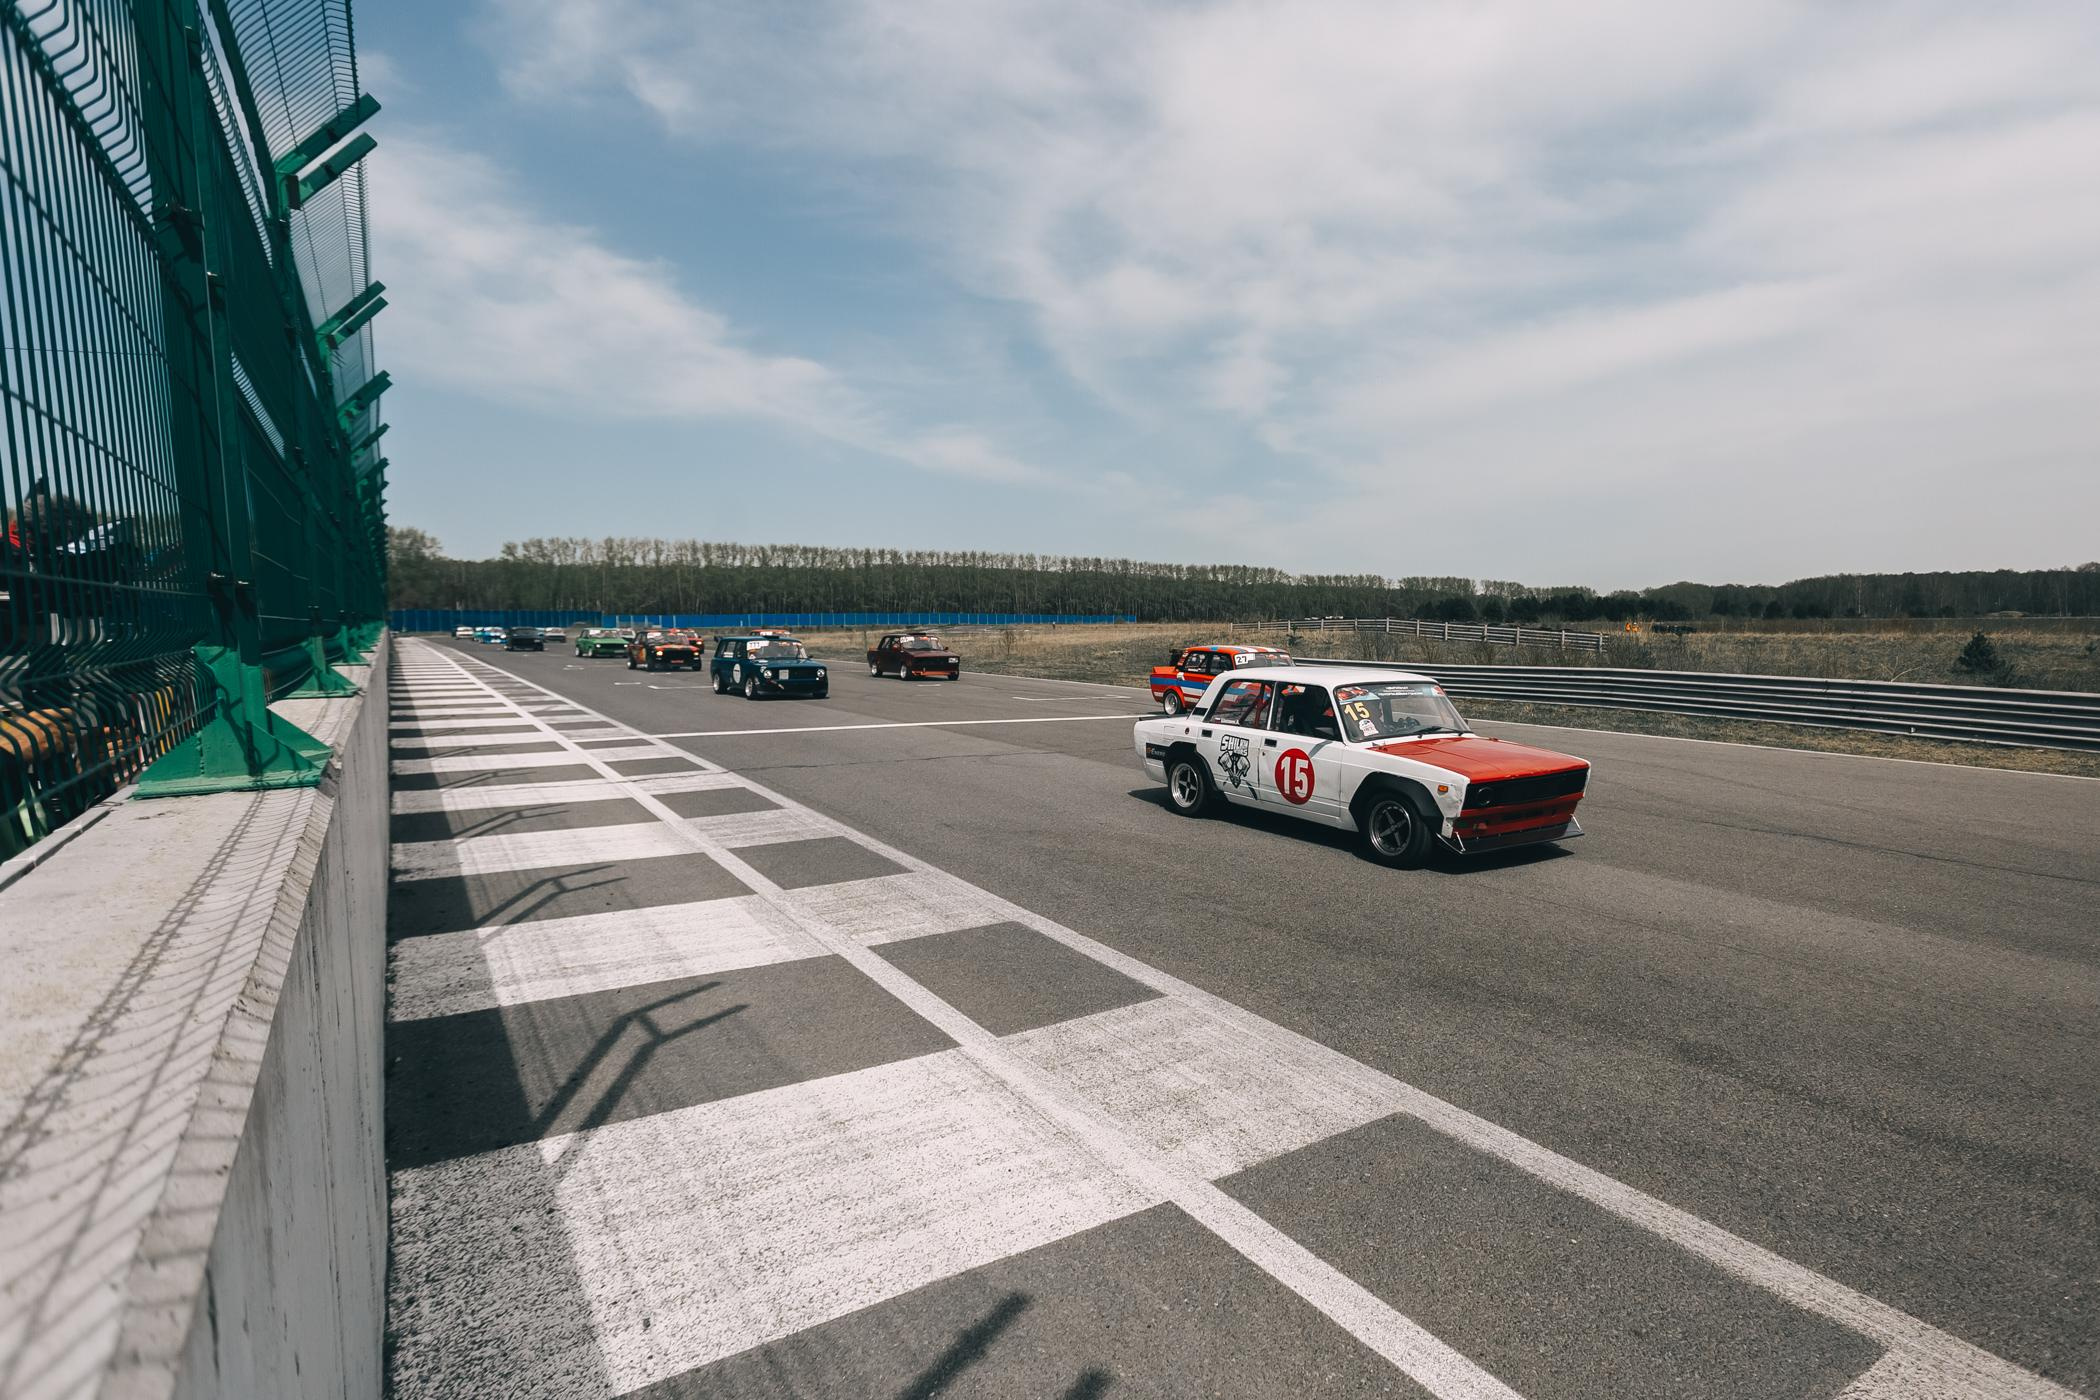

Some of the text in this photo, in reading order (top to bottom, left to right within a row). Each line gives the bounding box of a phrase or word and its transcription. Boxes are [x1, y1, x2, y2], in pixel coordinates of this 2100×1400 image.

[1236, 655, 1247, 663] 27
[1344, 702, 1370, 721] 15
[1280, 756, 1309, 798] 15
